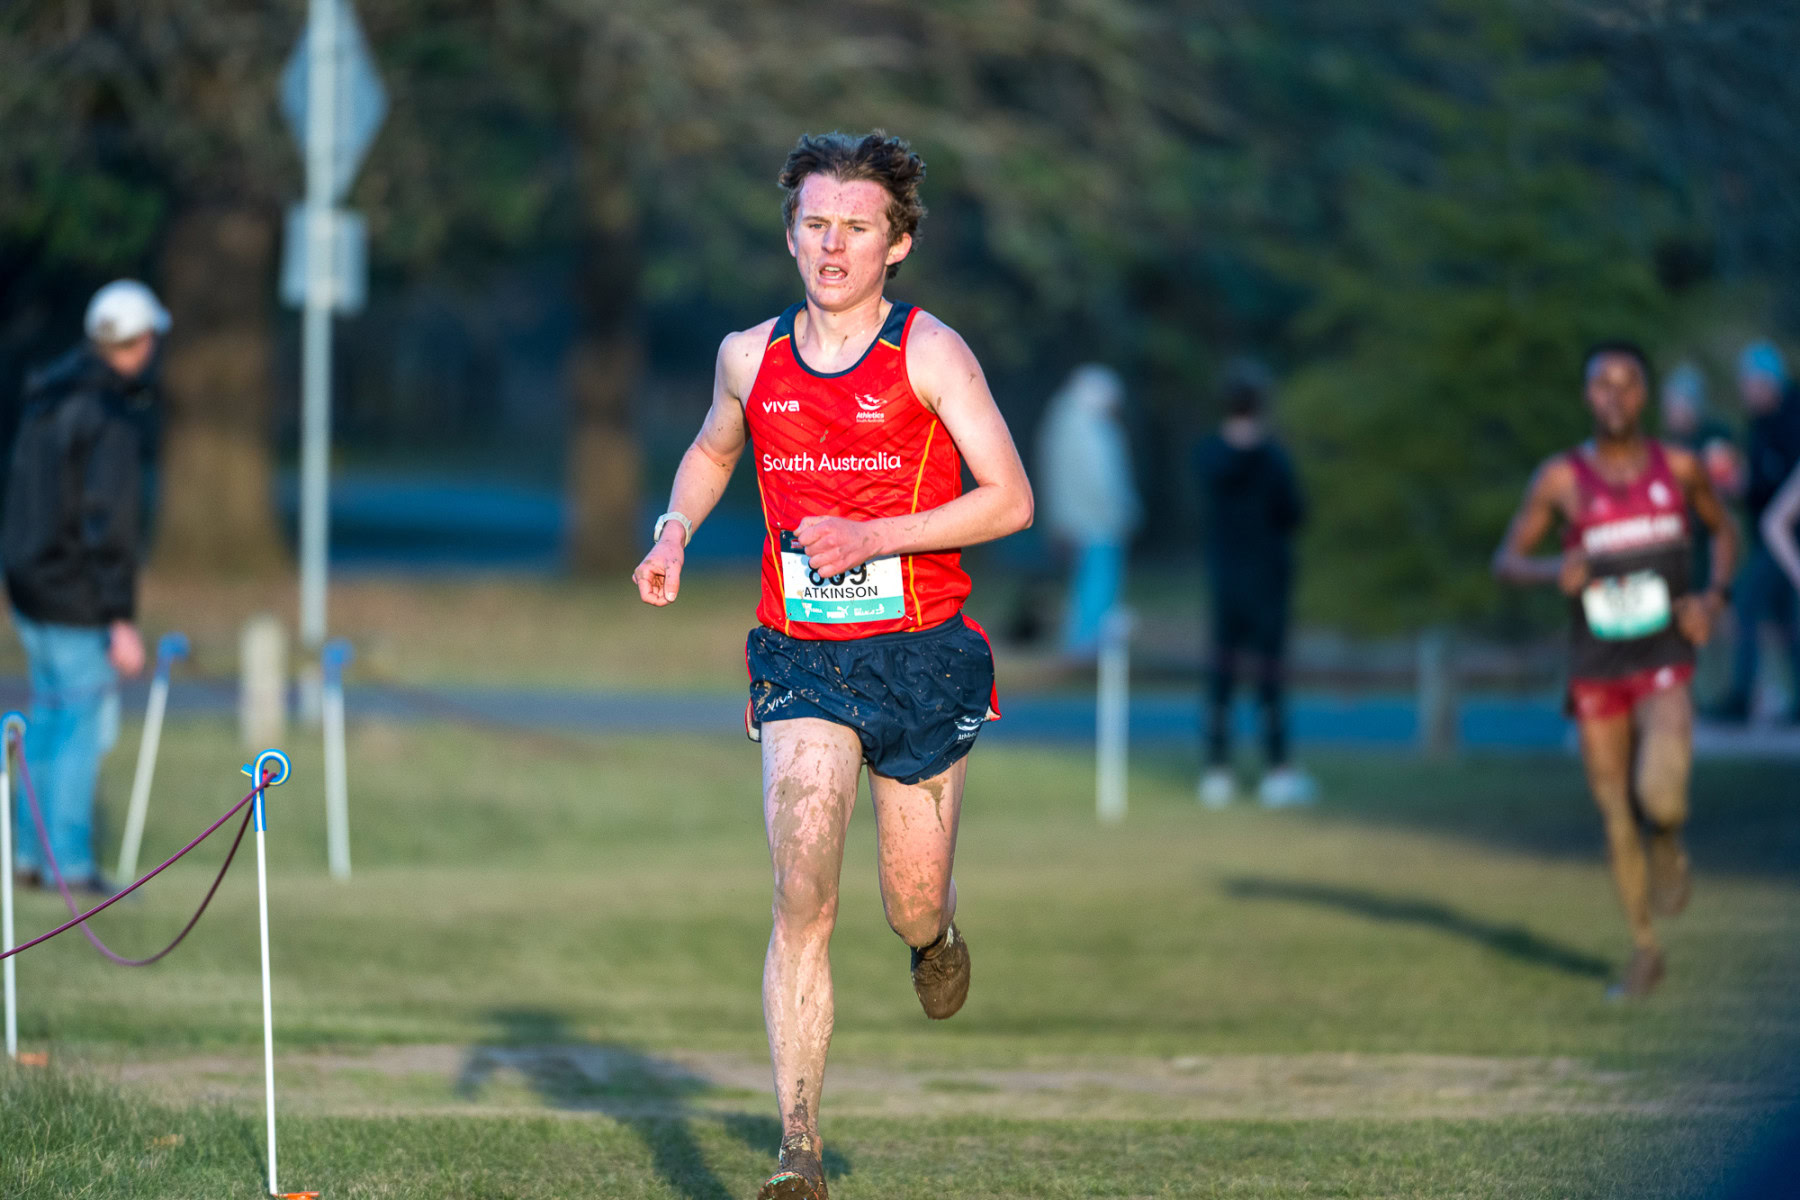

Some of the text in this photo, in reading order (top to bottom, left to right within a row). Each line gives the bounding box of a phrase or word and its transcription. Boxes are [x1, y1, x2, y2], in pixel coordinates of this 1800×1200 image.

[763, 452, 902, 472] South Australia
[804, 586, 878, 599] ATKINSON
